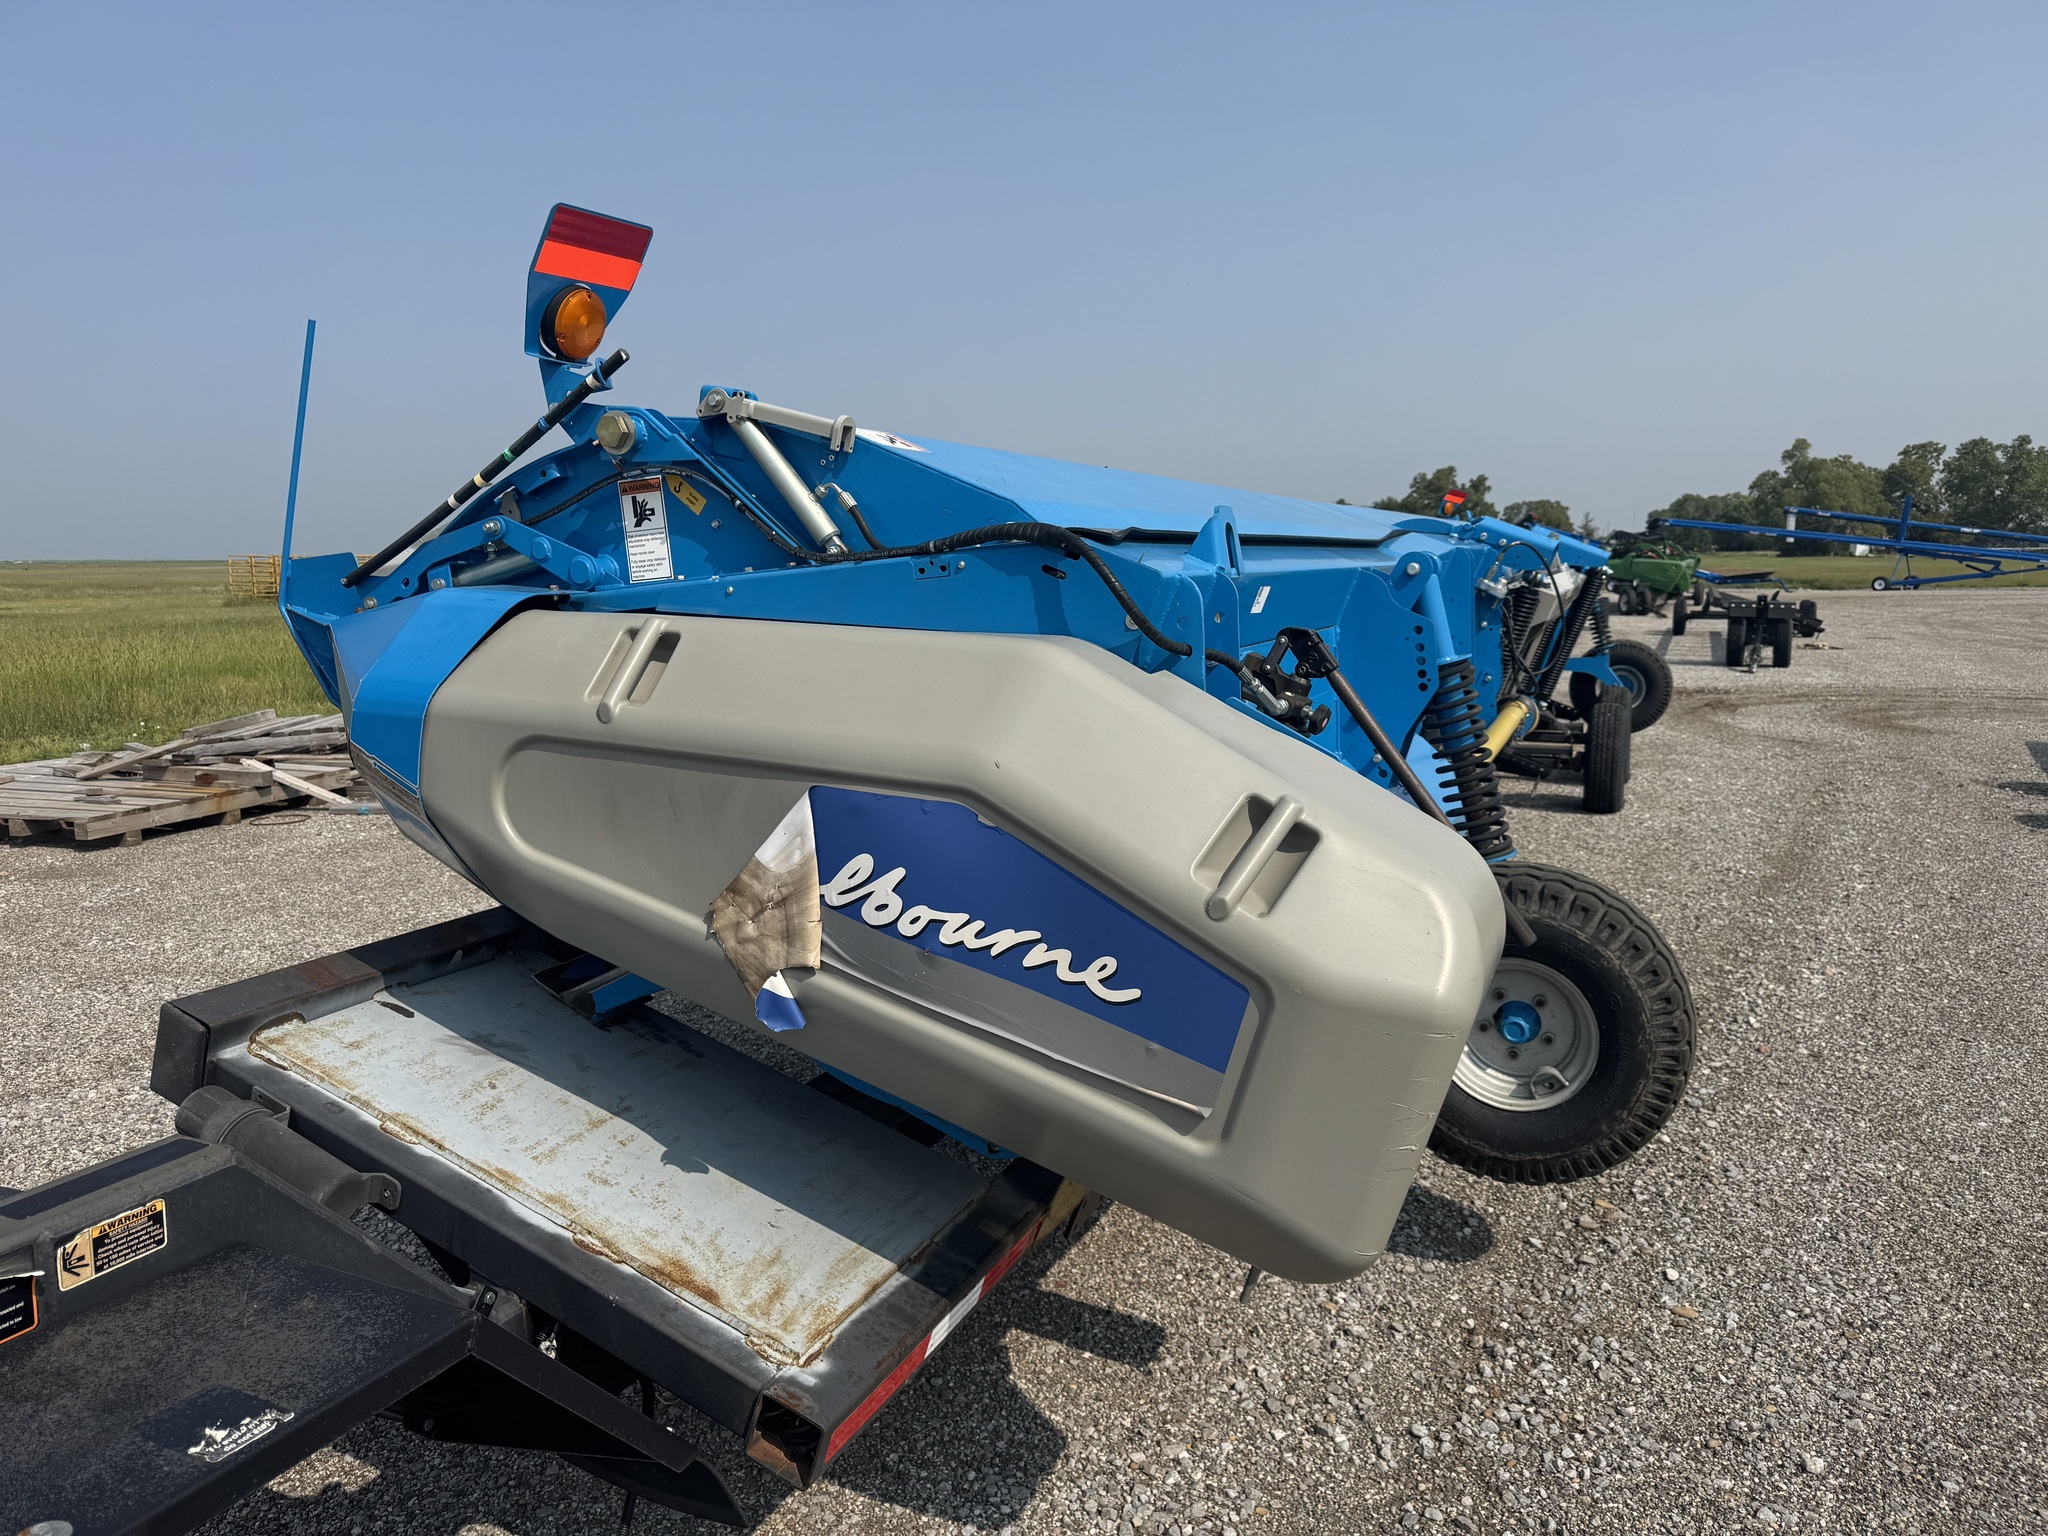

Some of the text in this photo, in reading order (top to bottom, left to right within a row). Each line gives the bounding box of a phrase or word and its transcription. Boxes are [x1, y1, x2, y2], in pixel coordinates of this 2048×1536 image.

[628, 481, 660, 492] WARNING
[686, 496, 697, 507] POINT
[689, 492, 700, 503] SLING
[107, 1204, 158, 1231] WARNING
[111, 1230, 129, 1242] prevent
[130, 1220, 153, 1234] equipment
[98, 1224, 160, 1254] damage and personal injury
[114, 1242, 128, 1252] wheel
[119, 1248, 131, 1257] miles
[138, 1238, 154, 1248] service
[126, 1252, 136, 1260] mile
[224, 1443, 236, 1452] do
[237, 1432, 254, 1444] not
